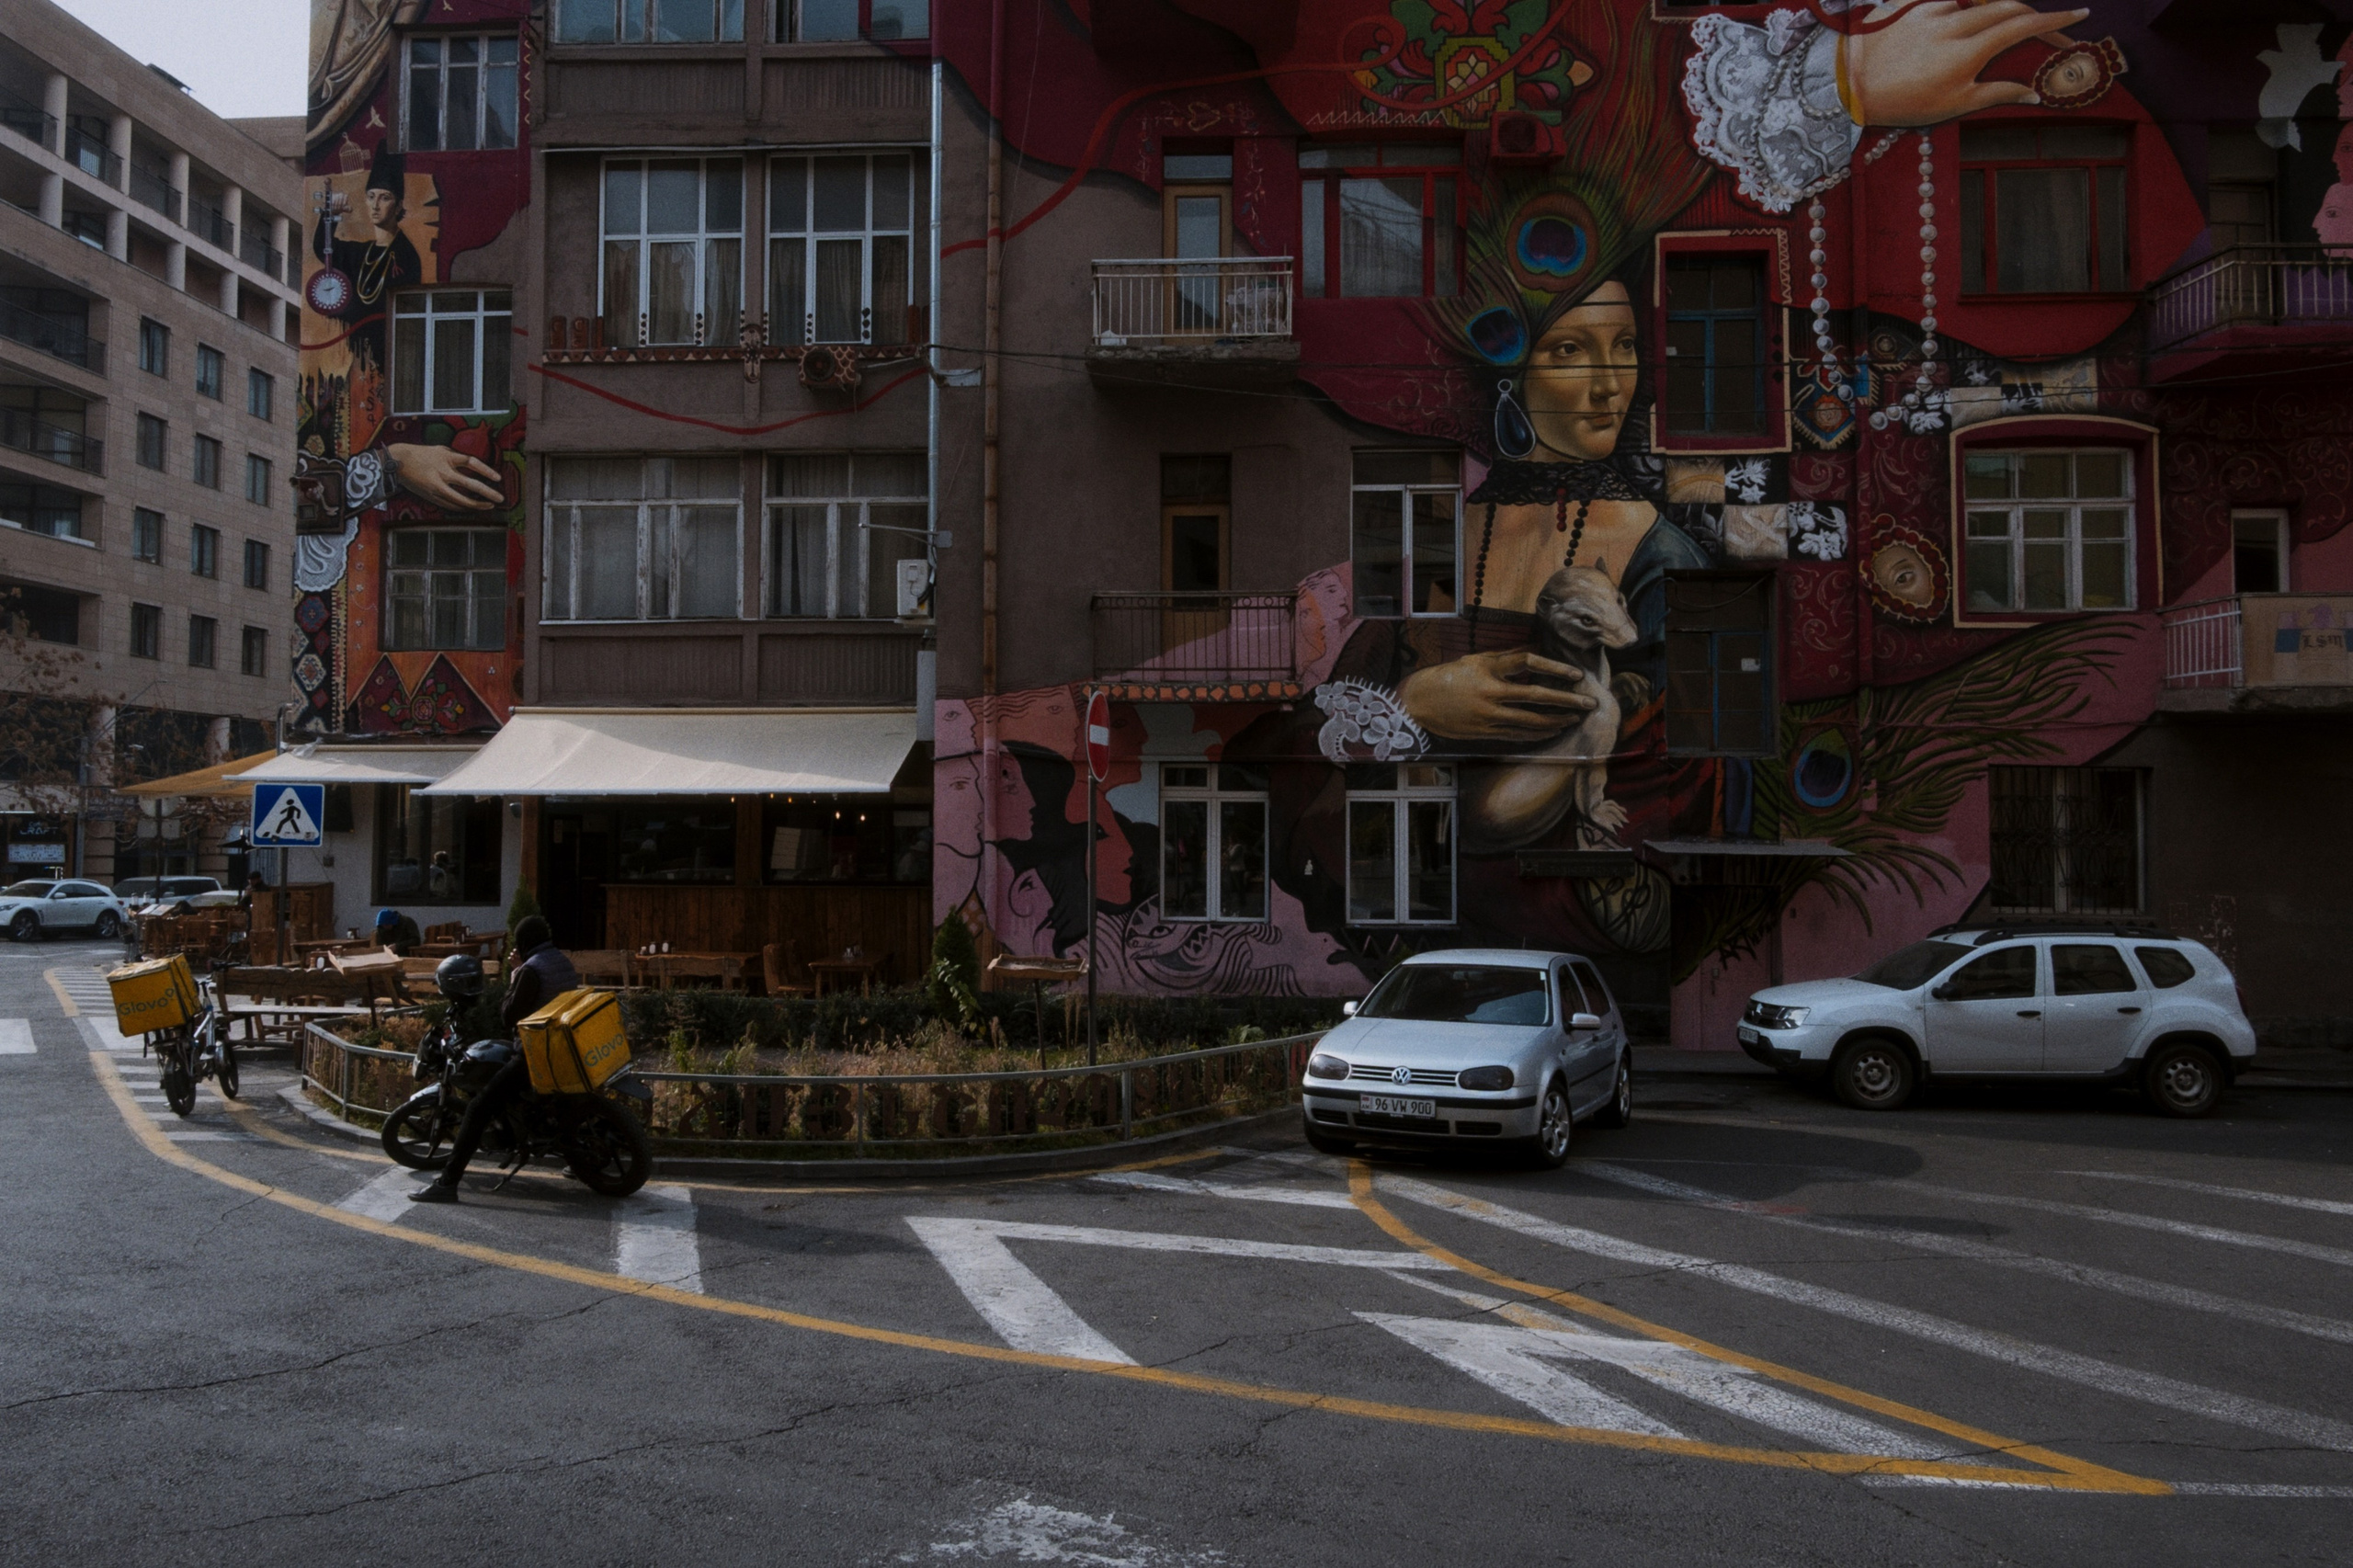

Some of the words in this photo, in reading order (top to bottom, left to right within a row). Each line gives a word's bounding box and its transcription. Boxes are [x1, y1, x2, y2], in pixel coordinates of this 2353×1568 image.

[119, 996, 169, 1016] Glovo
[584, 1033, 625, 1068] Glovo
[1375, 1097, 1388, 1111] 96
[1392, 1098, 1407, 1113] VW
[1411, 1101, 1432, 1115] 900
